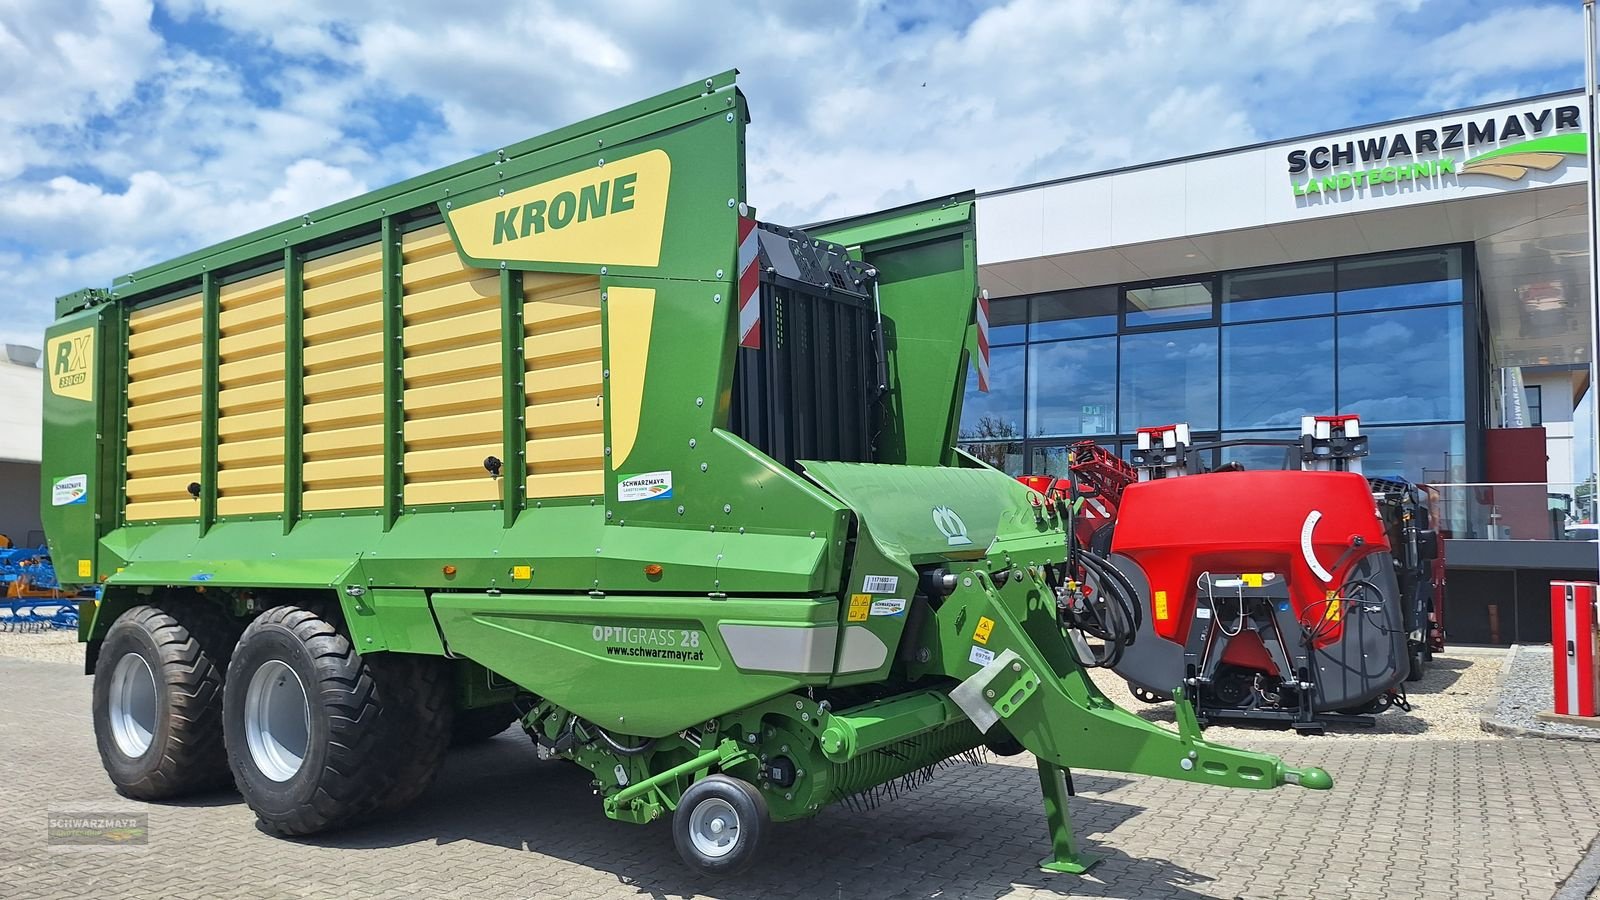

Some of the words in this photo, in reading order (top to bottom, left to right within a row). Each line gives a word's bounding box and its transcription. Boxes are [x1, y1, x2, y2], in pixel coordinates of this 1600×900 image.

[1287, 105, 1580, 173] SCHWARZMAYR
[1292, 158, 1456, 196] LANDTECHNIK
[493, 172, 637, 246] KRONE
[55, 334, 91, 376] RX
[622, 478, 665, 487] SCHWARZMAYR
[592, 625, 676, 646] OPTIGRASS
[680, 630, 700, 648] 28
[606, 645, 704, 662] www.schwarzmayr.at
